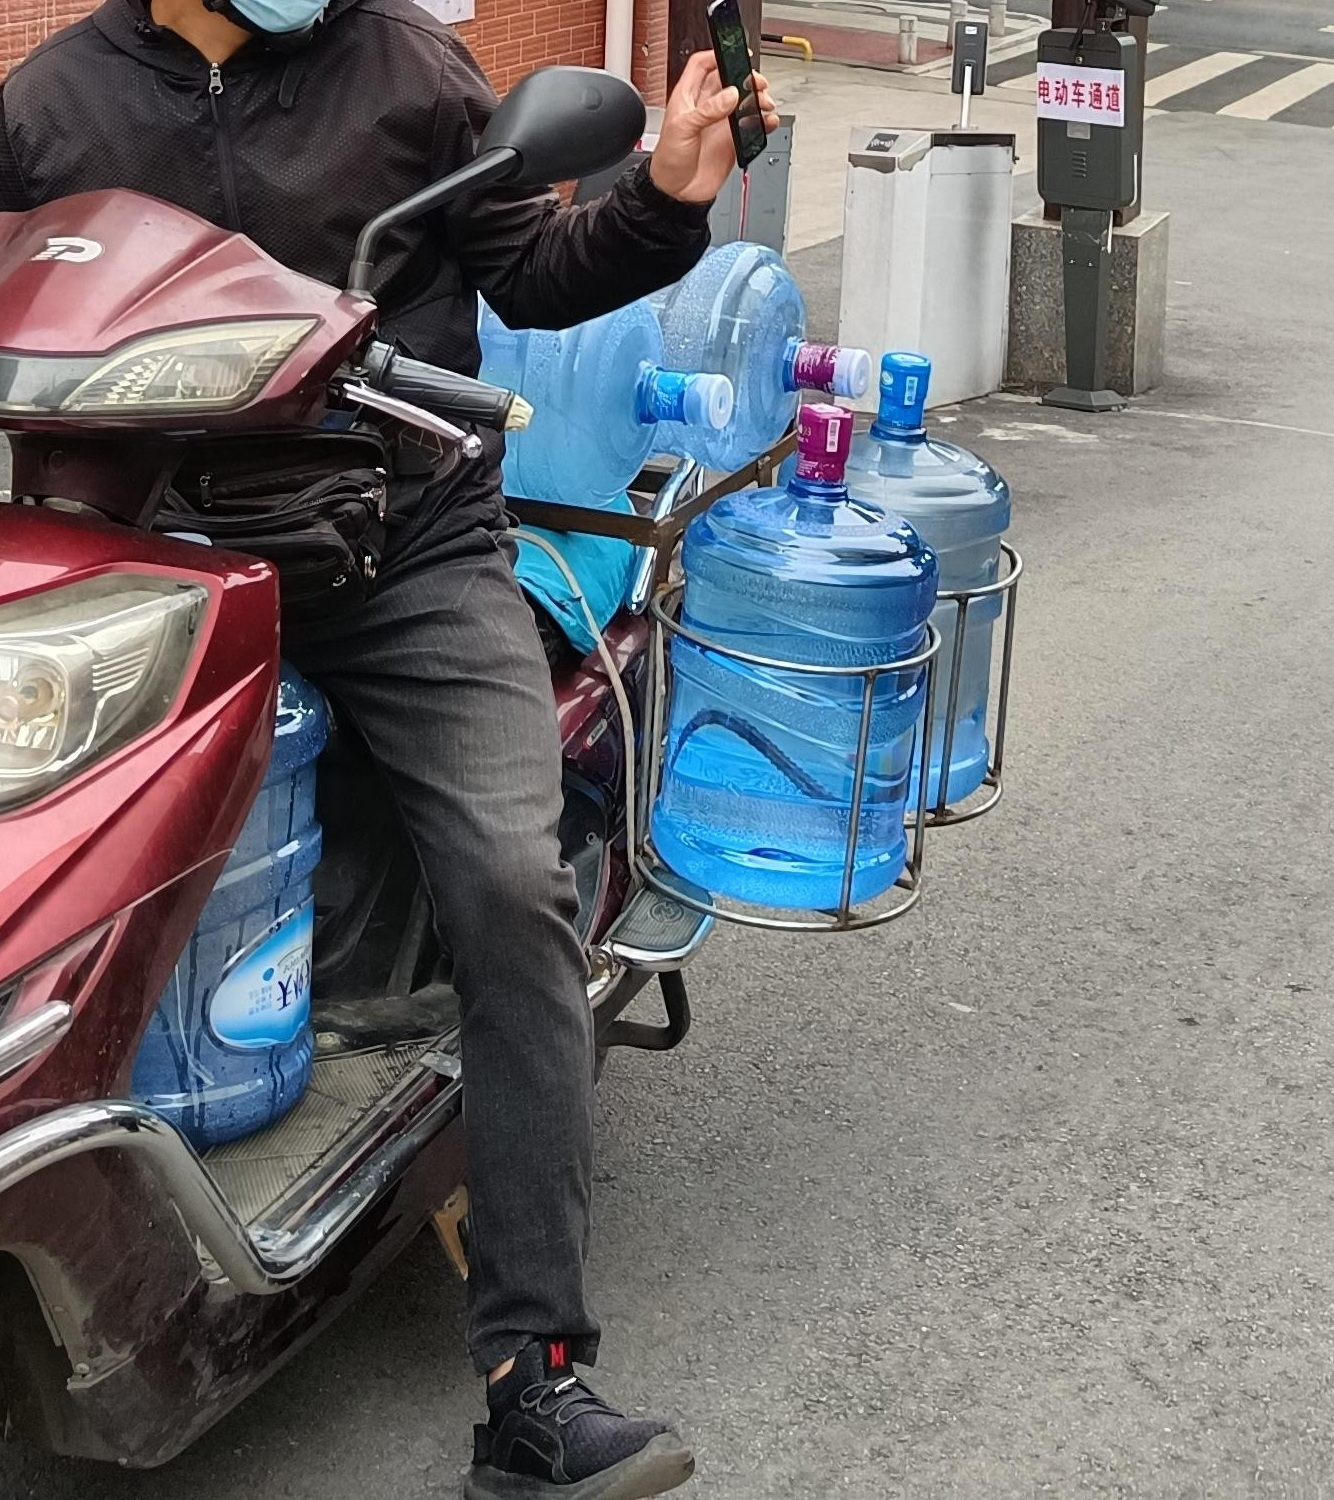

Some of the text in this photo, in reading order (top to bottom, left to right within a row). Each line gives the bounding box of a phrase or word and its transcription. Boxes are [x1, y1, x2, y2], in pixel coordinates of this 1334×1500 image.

[1038, 77, 1121, 113] 电动车通道
